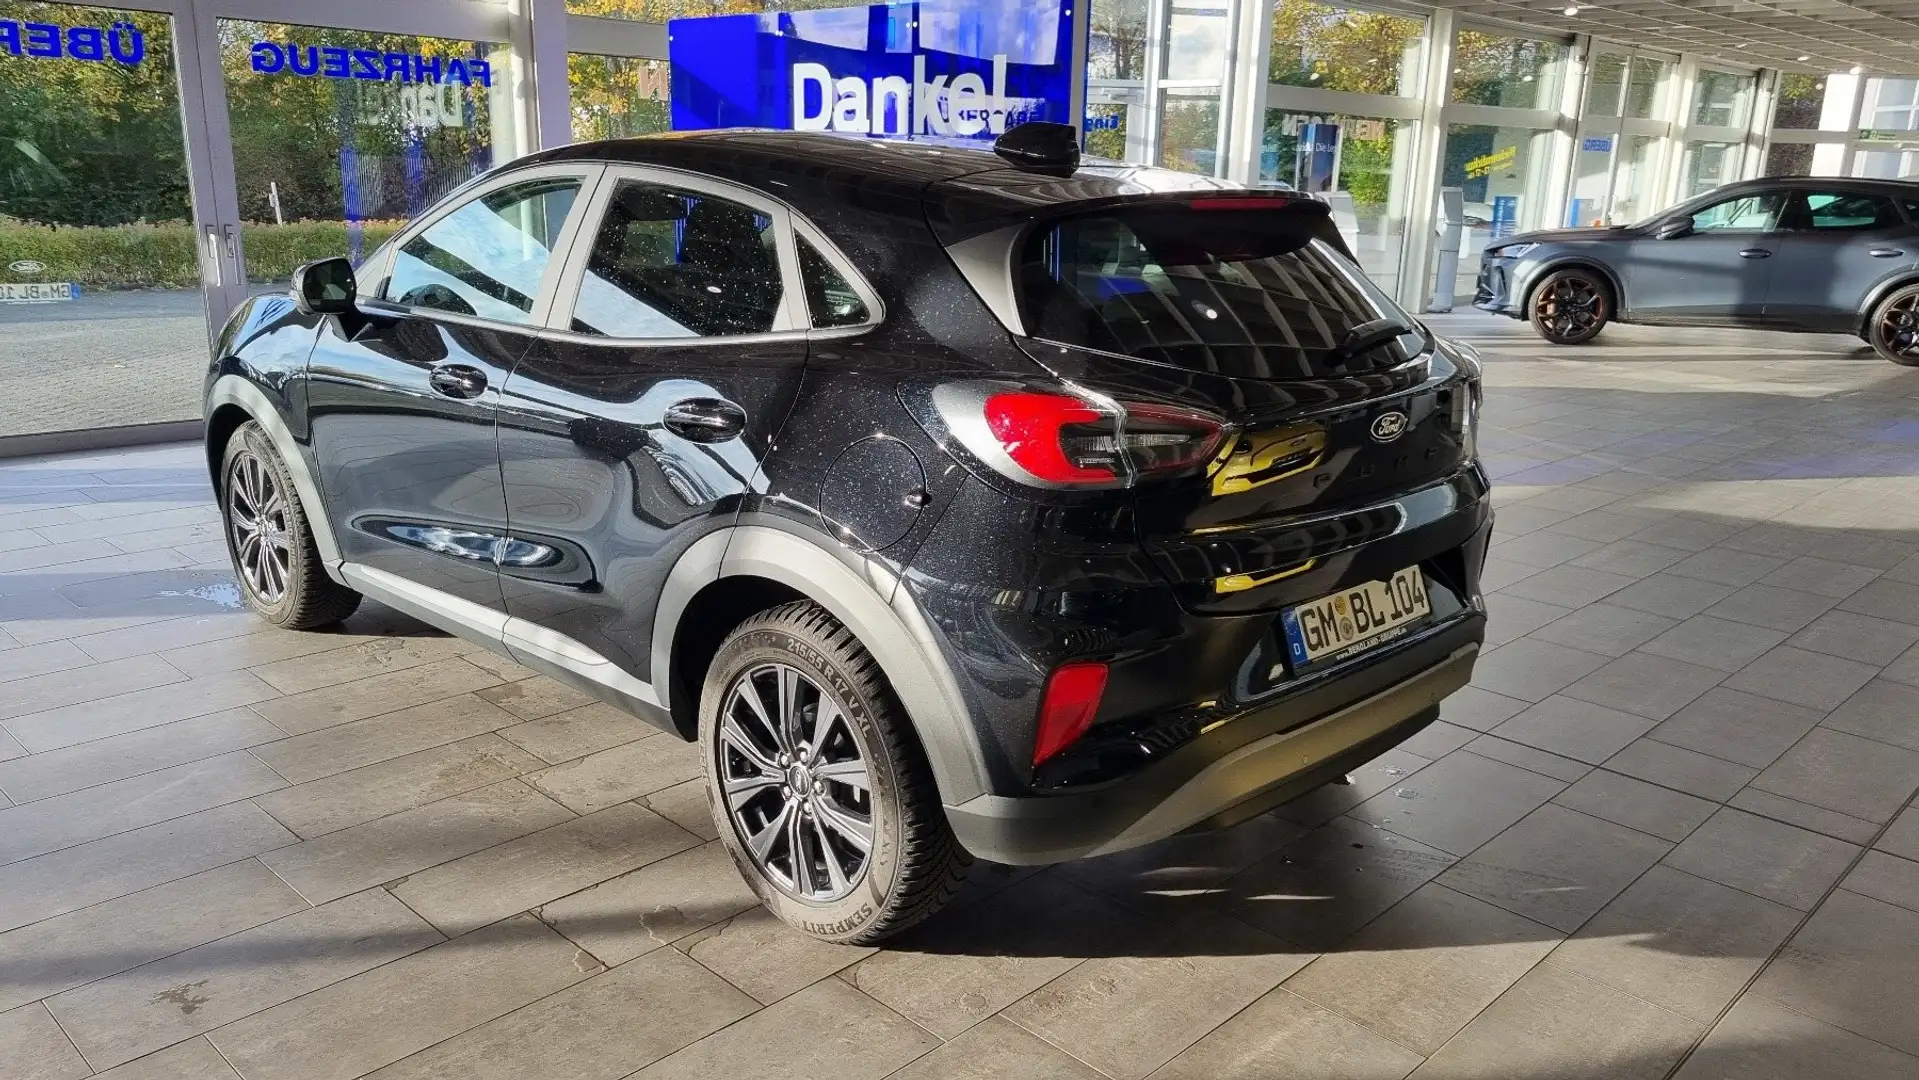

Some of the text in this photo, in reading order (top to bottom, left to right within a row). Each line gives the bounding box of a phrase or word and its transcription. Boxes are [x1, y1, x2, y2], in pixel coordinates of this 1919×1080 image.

[1301, 570, 1425, 652] GM BL 104
[1293, 643, 1301, 655] D
[786, 638, 871, 740] 215/55 R 17 V XL
[801, 902, 873, 936] SEMPERIT
